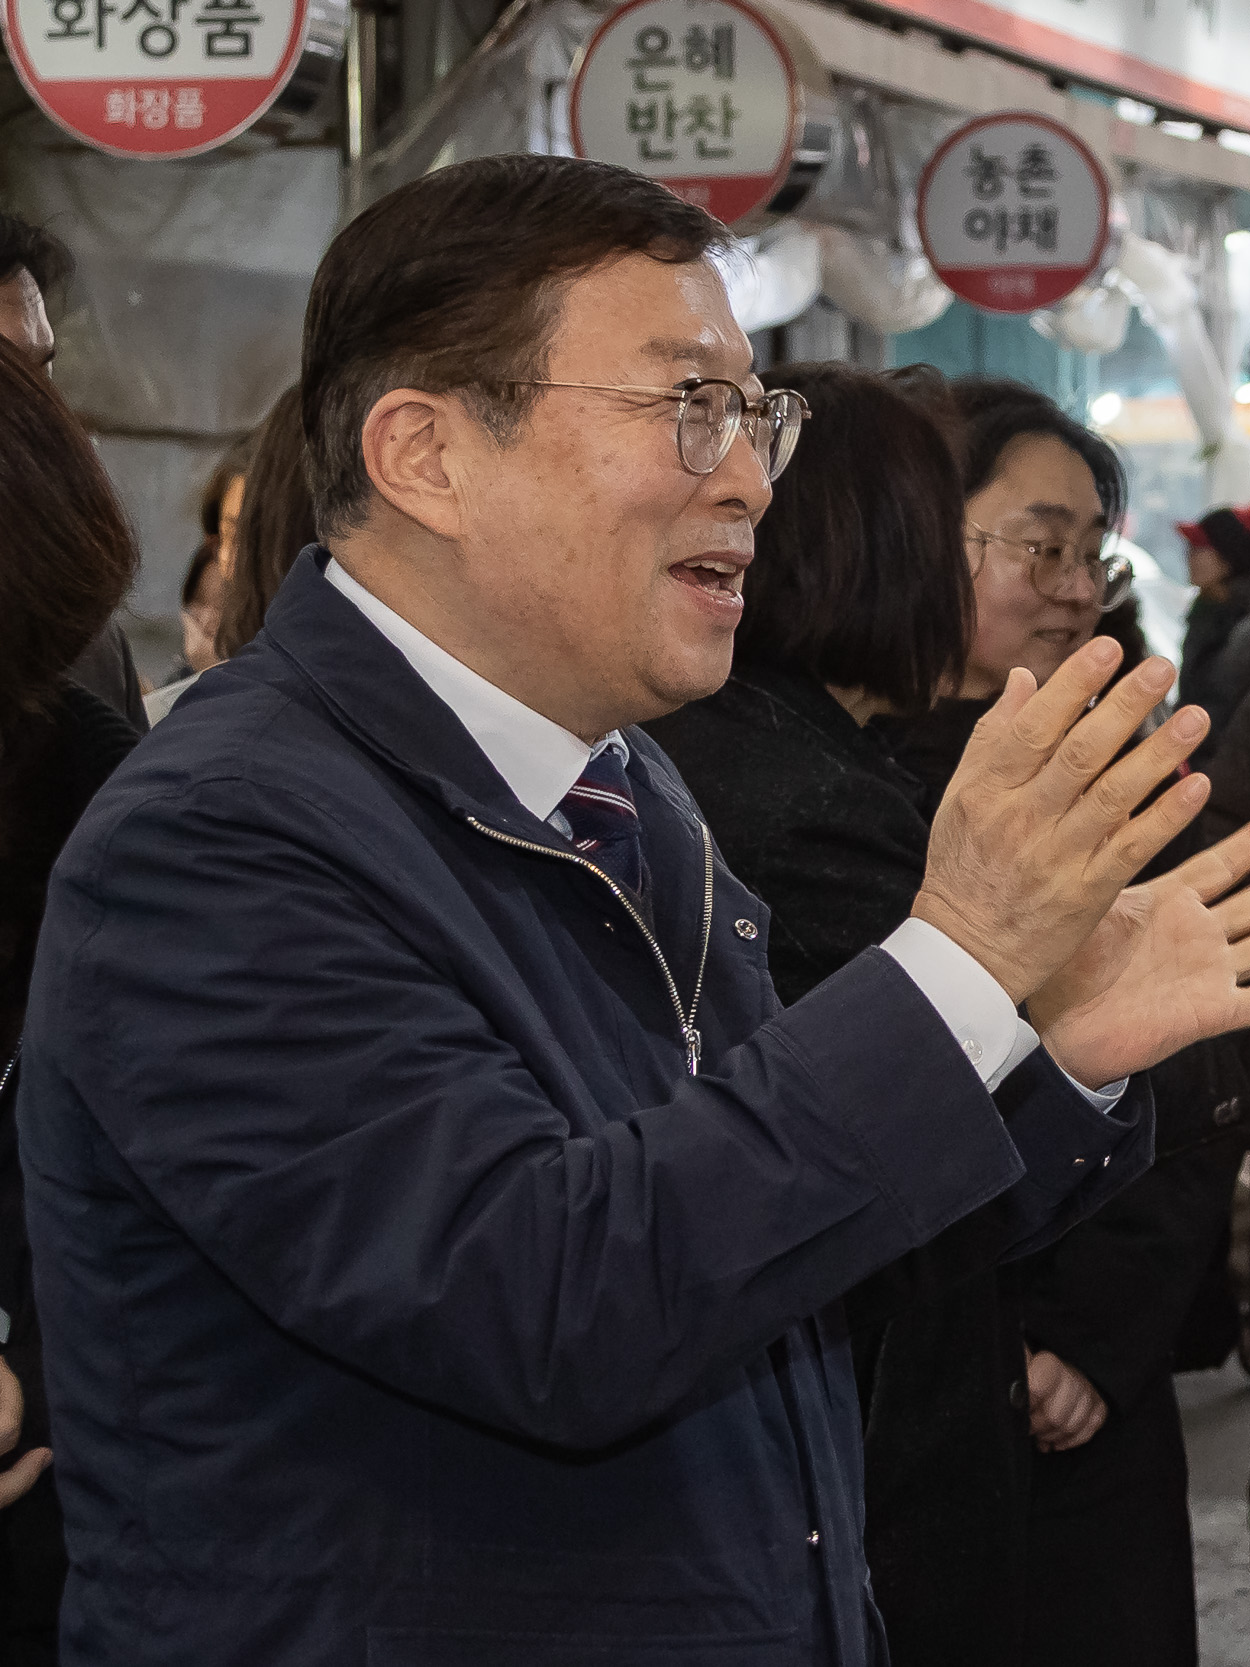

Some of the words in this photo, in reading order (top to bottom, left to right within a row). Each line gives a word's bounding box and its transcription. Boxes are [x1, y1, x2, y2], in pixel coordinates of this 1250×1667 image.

[625, 23, 736, 92] 은혜
[105, 87, 206, 129] 화장품
[625, 92, 741, 161] 반찬
[961, 142, 1060, 201] 농촌
